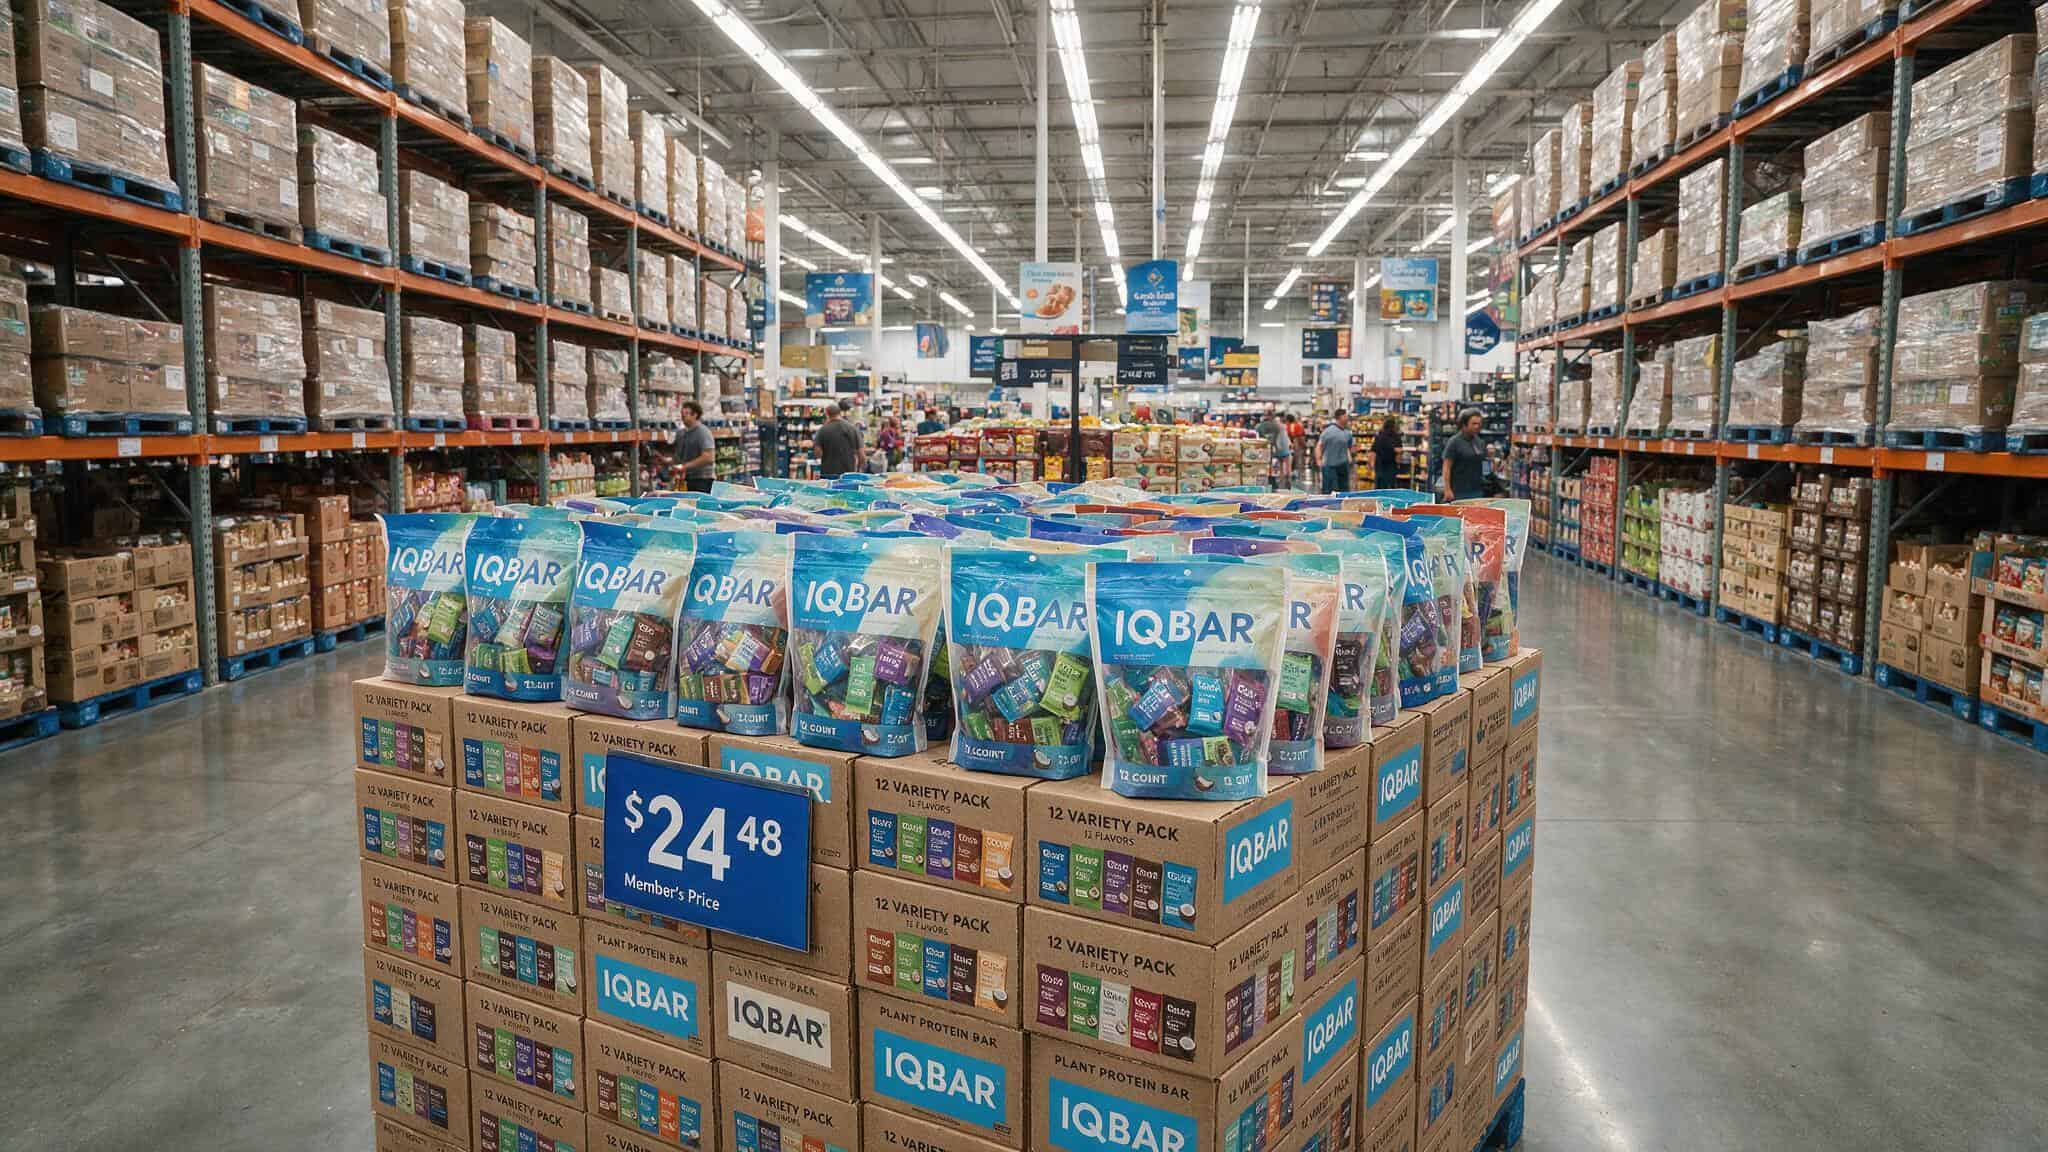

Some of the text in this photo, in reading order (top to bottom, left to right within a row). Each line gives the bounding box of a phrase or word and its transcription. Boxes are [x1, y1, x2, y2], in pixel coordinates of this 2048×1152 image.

[391, 547, 464, 576] IQBAR
[473, 553, 561, 585] IQBAR
[576, 560, 667, 596] IQBAR
[803, 580, 917, 617] IQBAR
[965, 592, 1089, 633] IQBAR
[1115, 608, 1254, 649] IQBAR
[366, 695, 433, 714] 12 VARIETY PACK
[467, 713, 548, 735] 12 VARIETY PACK
[590, 731, 677, 757] 12 VARIETY PACK
[367, 785, 434, 808] 12 VARIETY PACK
[875, 778, 991, 810] 12 VARIETY PACK
[1380, 759, 1418, 806] IQBAR
[469, 810, 549, 836] 12 VARIETY PACK
[1048, 806, 1179, 842] 12 VARIETY PACK
[590, 836, 600, 849] 12
[1229, 818, 1288, 880] IQBAR
[373, 878, 440, 905] 12 VARIETY PACK
[624, 872, 720, 911] Member's Price
[480, 902, 558, 931] 12 VARIETY PACK
[875, 897, 990, 934] 12 VARIETY PACK
[1432, 890, 1462, 937] IQBAR
[597, 934, 688, 968] PLANT PROTEIN BAR
[1047, 935, 1177, 977] 12 VARIETY PACK
[1239, 934, 1269, 965] VARIETY
[376, 960, 441, 990] 12 VARIETY PACK
[603, 968, 689, 1022] IQBAR
[480, 999, 559, 1034] 12 VARIETY PACK
[733, 996, 824, 1049] IQBAR
[879, 1006, 998, 1049] PLANT PROTEIN BAR
[1308, 996, 1353, 1063] IQBAR
[426, 1060, 449, 1078] PACK
[600, 1045, 688, 1083] 12 VARIETY PACK
[885, 1046, 996, 1110] IQBAR
[1055, 1055, 1191, 1101] PLANT PROTEIN BAR
[1371, 1030, 1409, 1093] IQBAR
[484, 1089, 564, 1128] 12 VARIETY PACK
[739, 1087, 833, 1127] 12 VARIETY PACK
[1061, 1096, 1186, 1152] IQBAR
[606, 1135, 617, 1147] 12
[884, 1130, 898, 1145] 12
